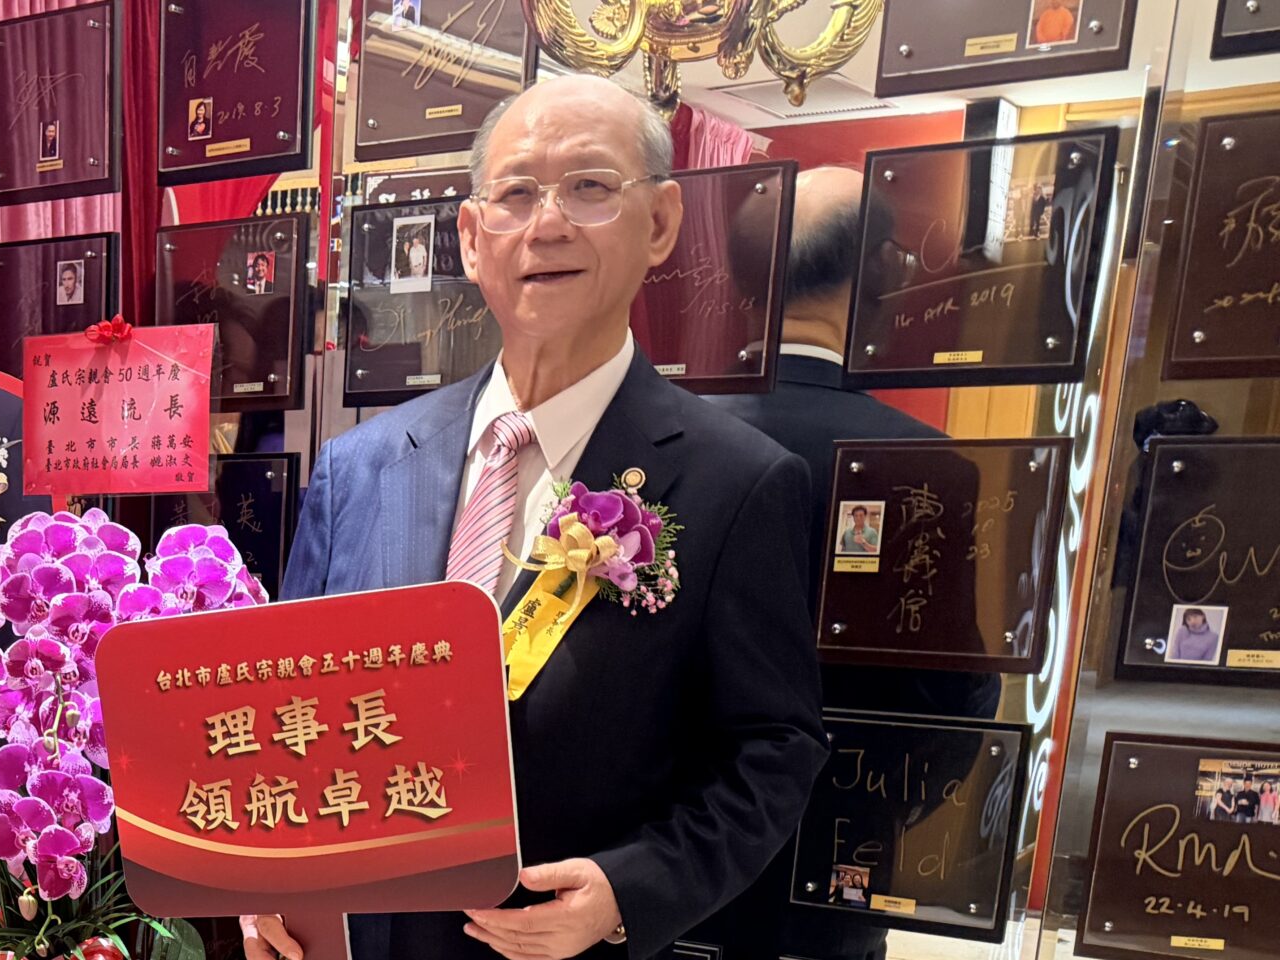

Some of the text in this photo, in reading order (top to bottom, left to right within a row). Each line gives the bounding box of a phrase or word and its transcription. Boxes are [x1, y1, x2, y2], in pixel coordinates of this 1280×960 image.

[970, 282, 1015, 307] 2019
[156, 639, 453, 691] 台北市盧氏宗親會五十週年慶典
[206, 688, 403, 757] 理事長
[179, 761, 453, 831] 領航卓越
[832, 749, 967, 806] Julia
[833, 818, 950, 881] Feld
